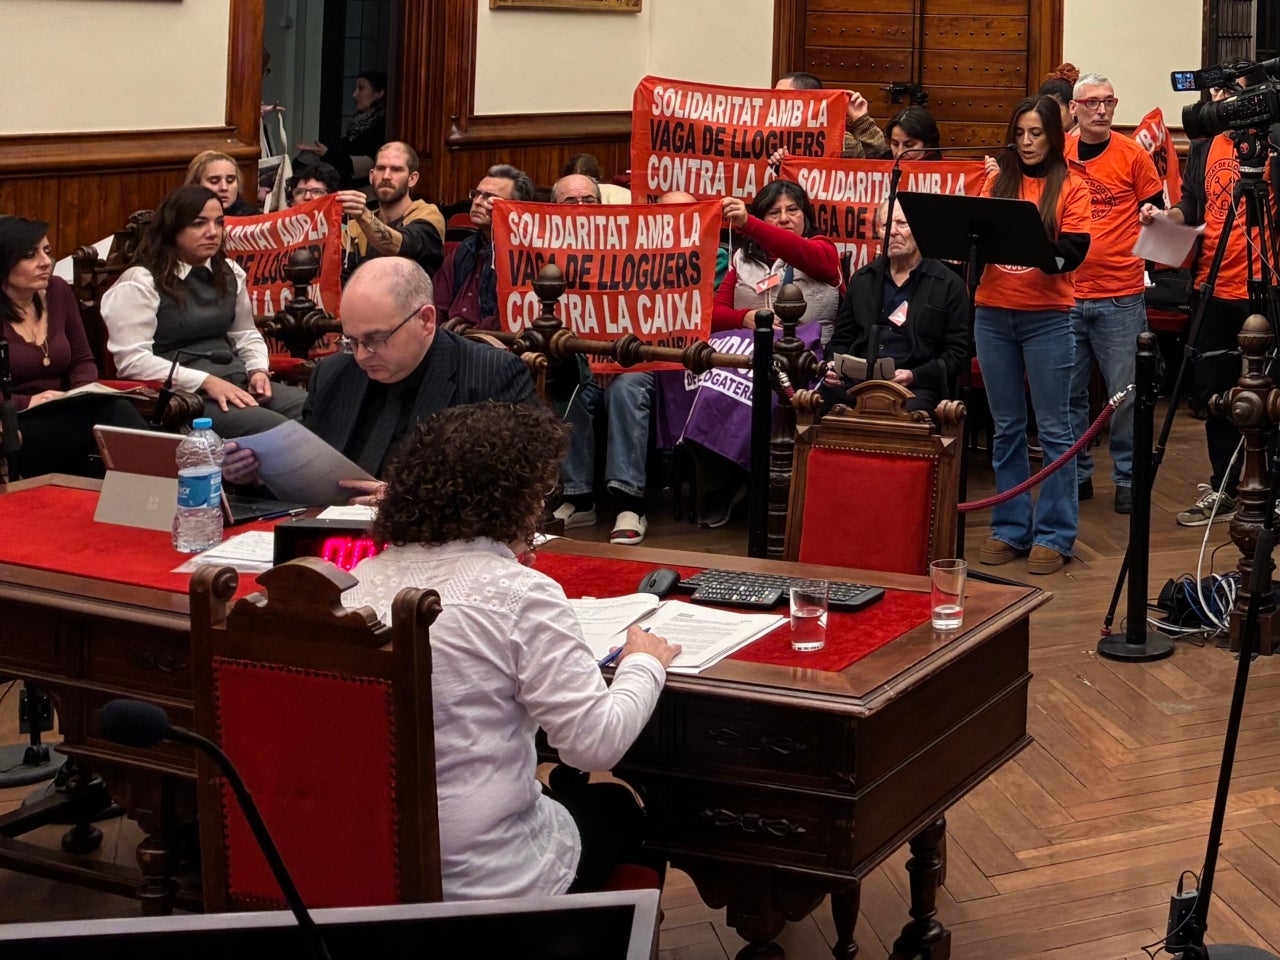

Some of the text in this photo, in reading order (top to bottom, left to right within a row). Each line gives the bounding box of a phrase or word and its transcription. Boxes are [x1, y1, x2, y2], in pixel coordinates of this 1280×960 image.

[652, 86, 828, 128] SOLIDARITAT AMB LA
[650, 119, 696, 154] VAGA
[702, 126, 726, 158] DE
[647, 154, 726, 196] CONTRA
[732, 162, 757, 198] LA
[798, 168, 901, 203] SOLIDARITA
[908, 173, 941, 195] AMB
[308, 210, 329, 241] LA
[508, 211, 701, 250] SOLIDARITAT AMB LA
[845, 206, 868, 240] DE
[566, 253, 594, 290] DE
[598, 250, 702, 291] LLOGUERS
[507, 289, 702, 335] COTRA LA CAIXA
